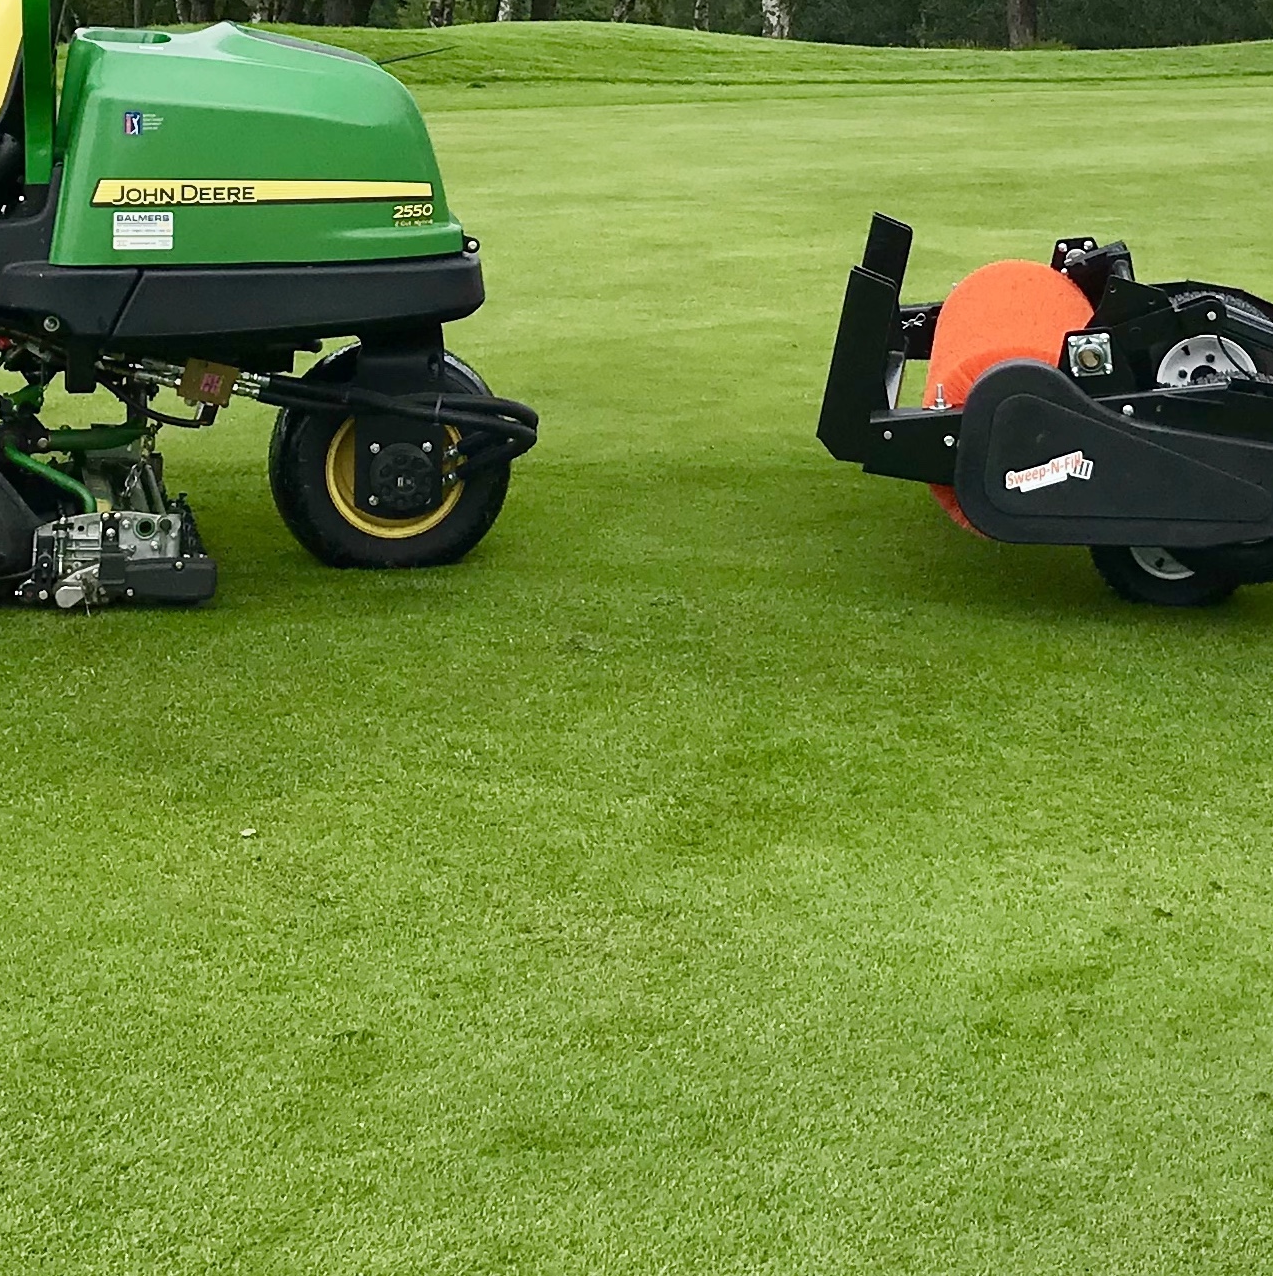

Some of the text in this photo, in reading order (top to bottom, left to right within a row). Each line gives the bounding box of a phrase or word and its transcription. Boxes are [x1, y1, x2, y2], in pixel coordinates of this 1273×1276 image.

[113, 184, 255, 202] JOHN DEERE
[116, 214, 170, 222] BALMERS
[393, 203, 433, 218] 2550
